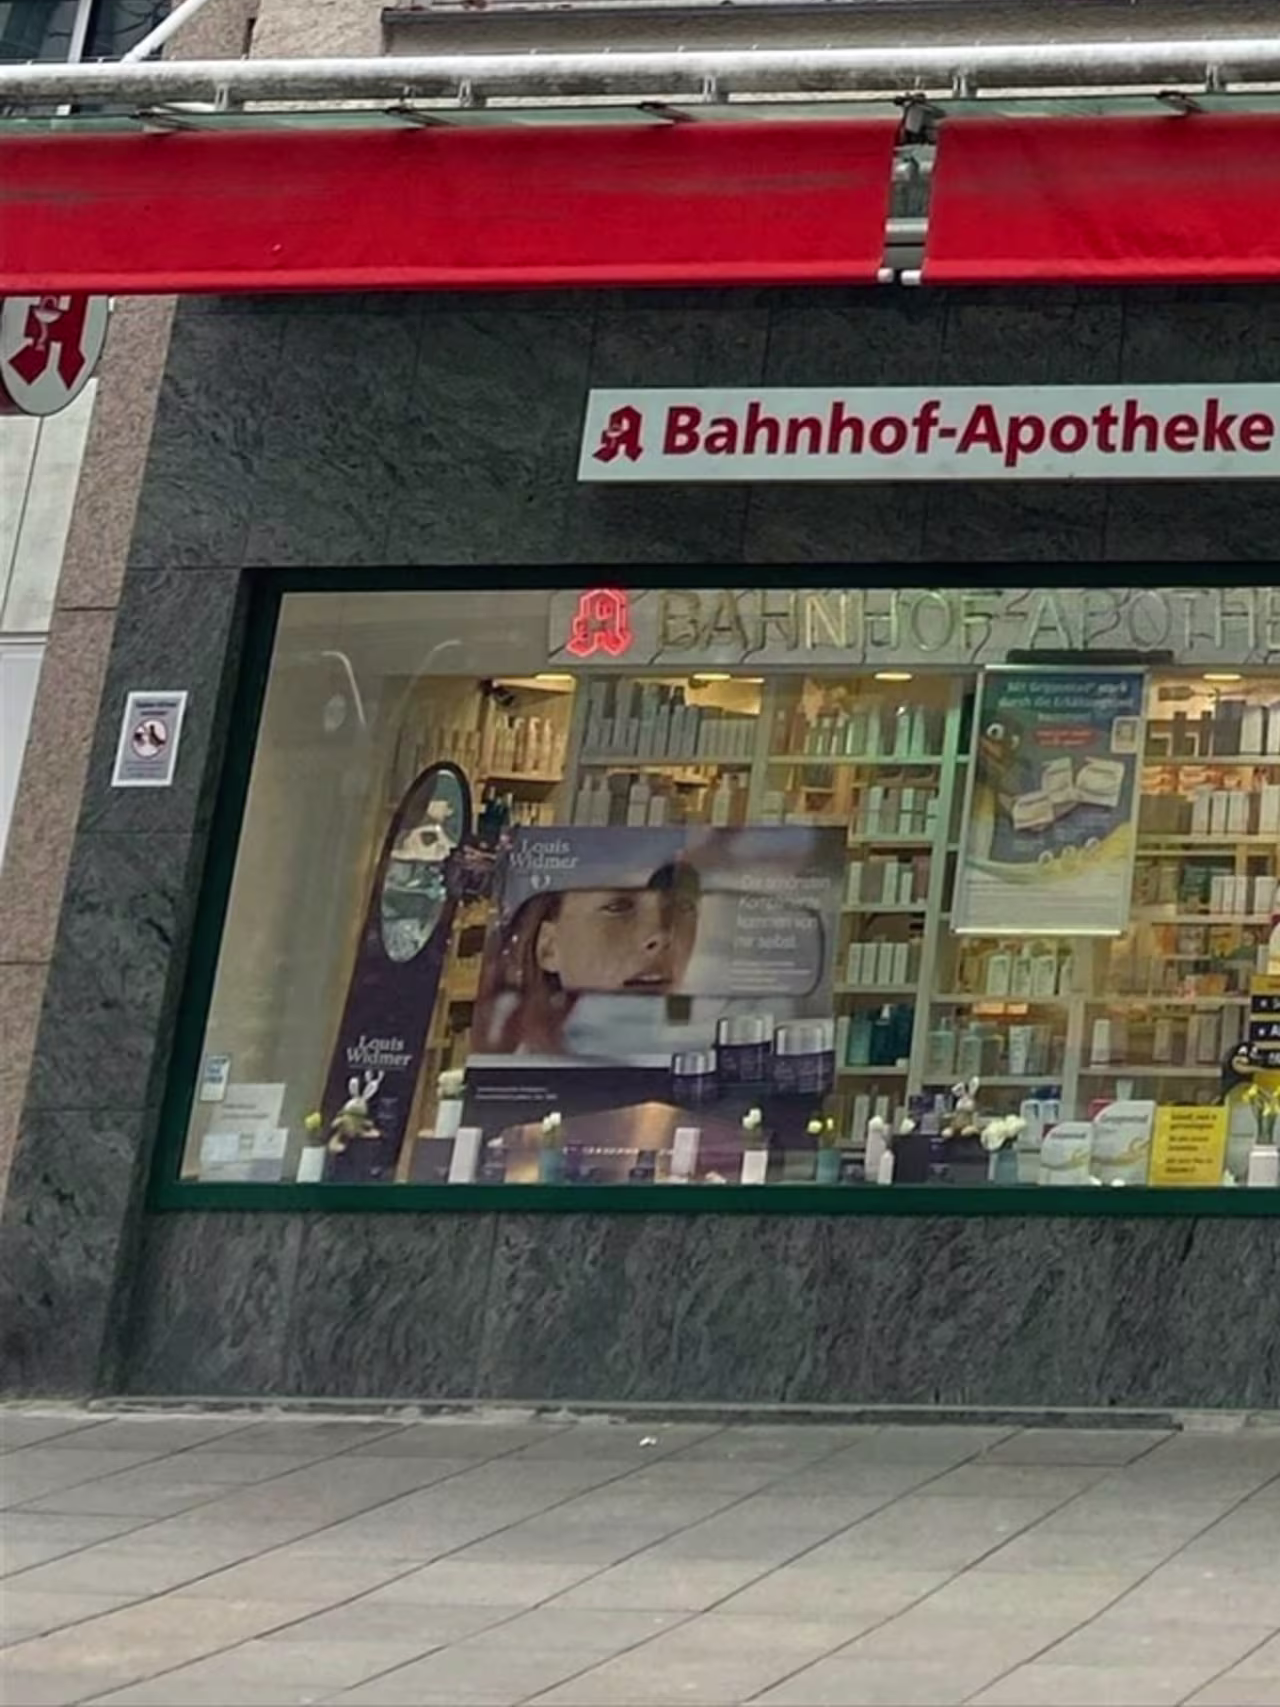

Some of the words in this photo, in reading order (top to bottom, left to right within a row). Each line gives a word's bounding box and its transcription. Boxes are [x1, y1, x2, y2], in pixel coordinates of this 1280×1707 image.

[662, 398, 1275, 467] Bahnhof-Apotheke
[520, 839, 570, 854] Louis
[510, 852, 579, 870] Widmer
[357, 1035, 405, 1052] Louis
[346, 1047, 413, 1067] Widmer
